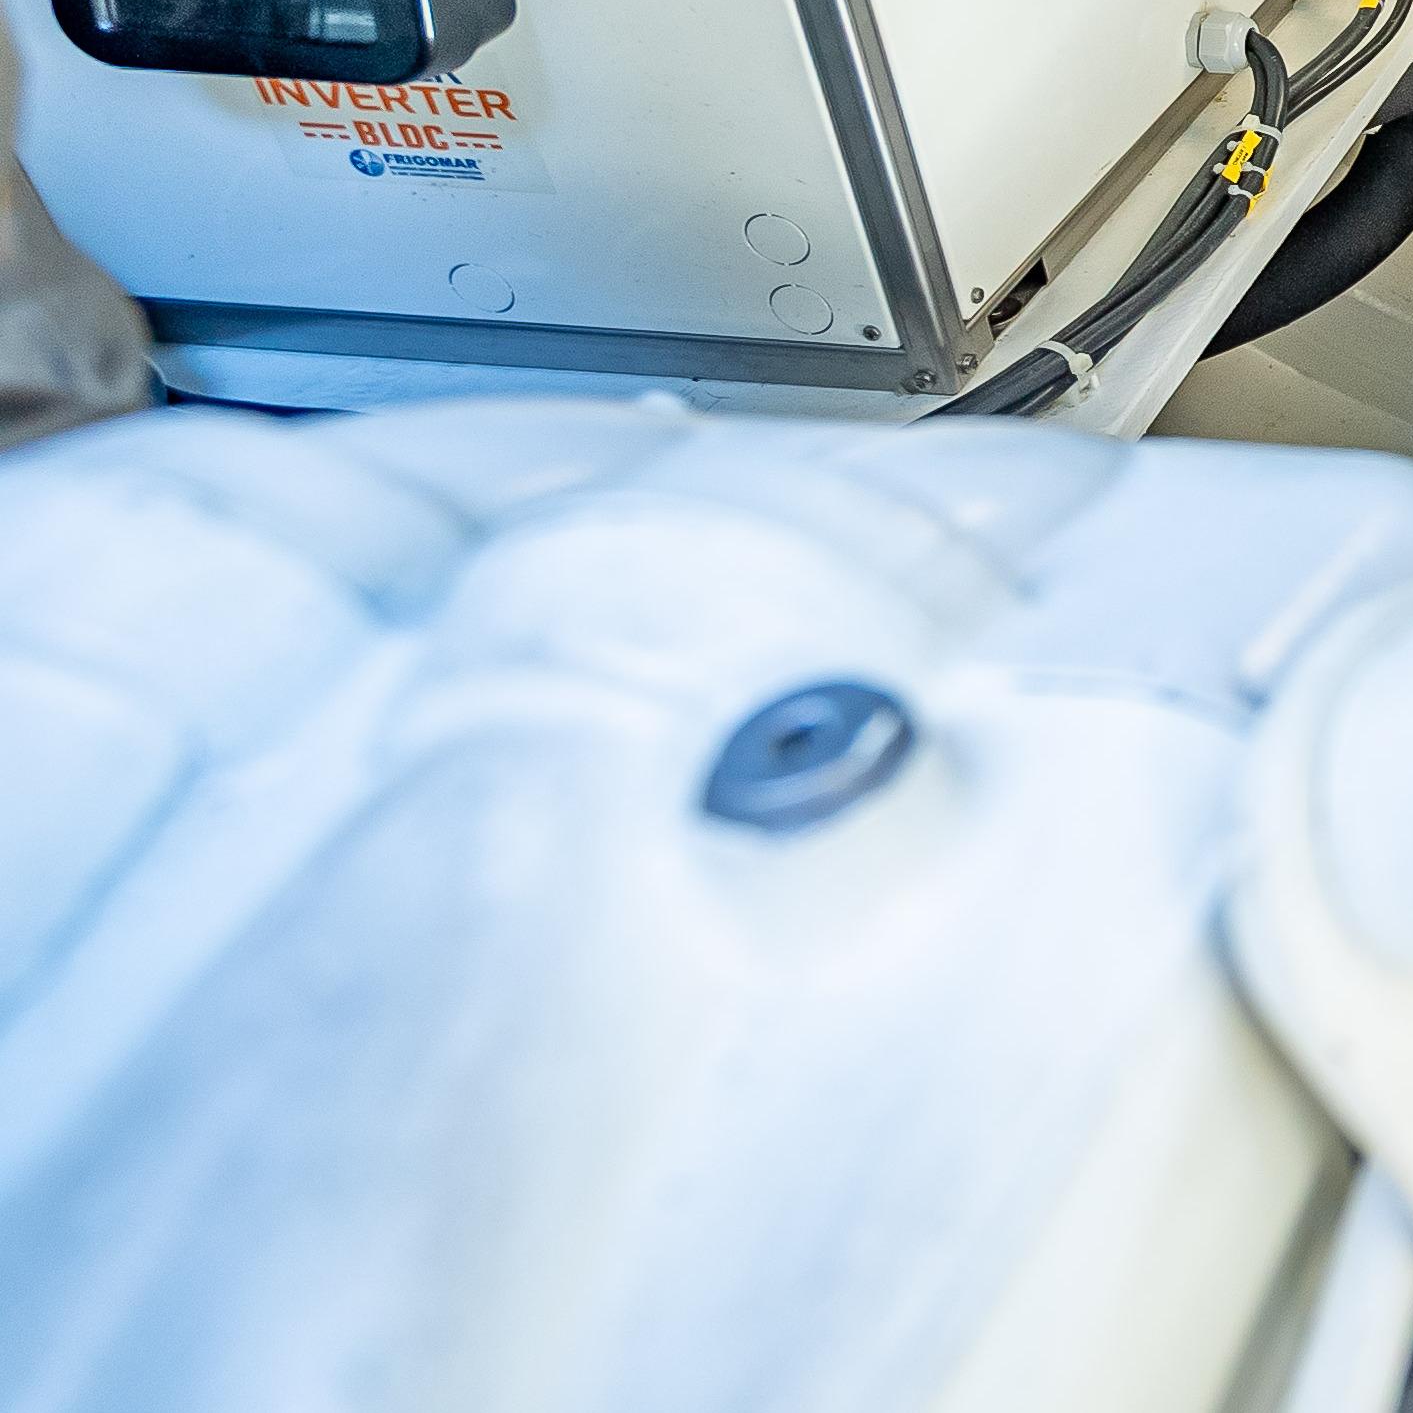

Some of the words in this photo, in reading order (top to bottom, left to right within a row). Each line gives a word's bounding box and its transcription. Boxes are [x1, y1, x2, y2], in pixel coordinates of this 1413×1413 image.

[254, 76, 517, 121] INVERTER
[353, 120, 450, 151] BLDC
[382, 153, 479, 171] FRIGOMAR
